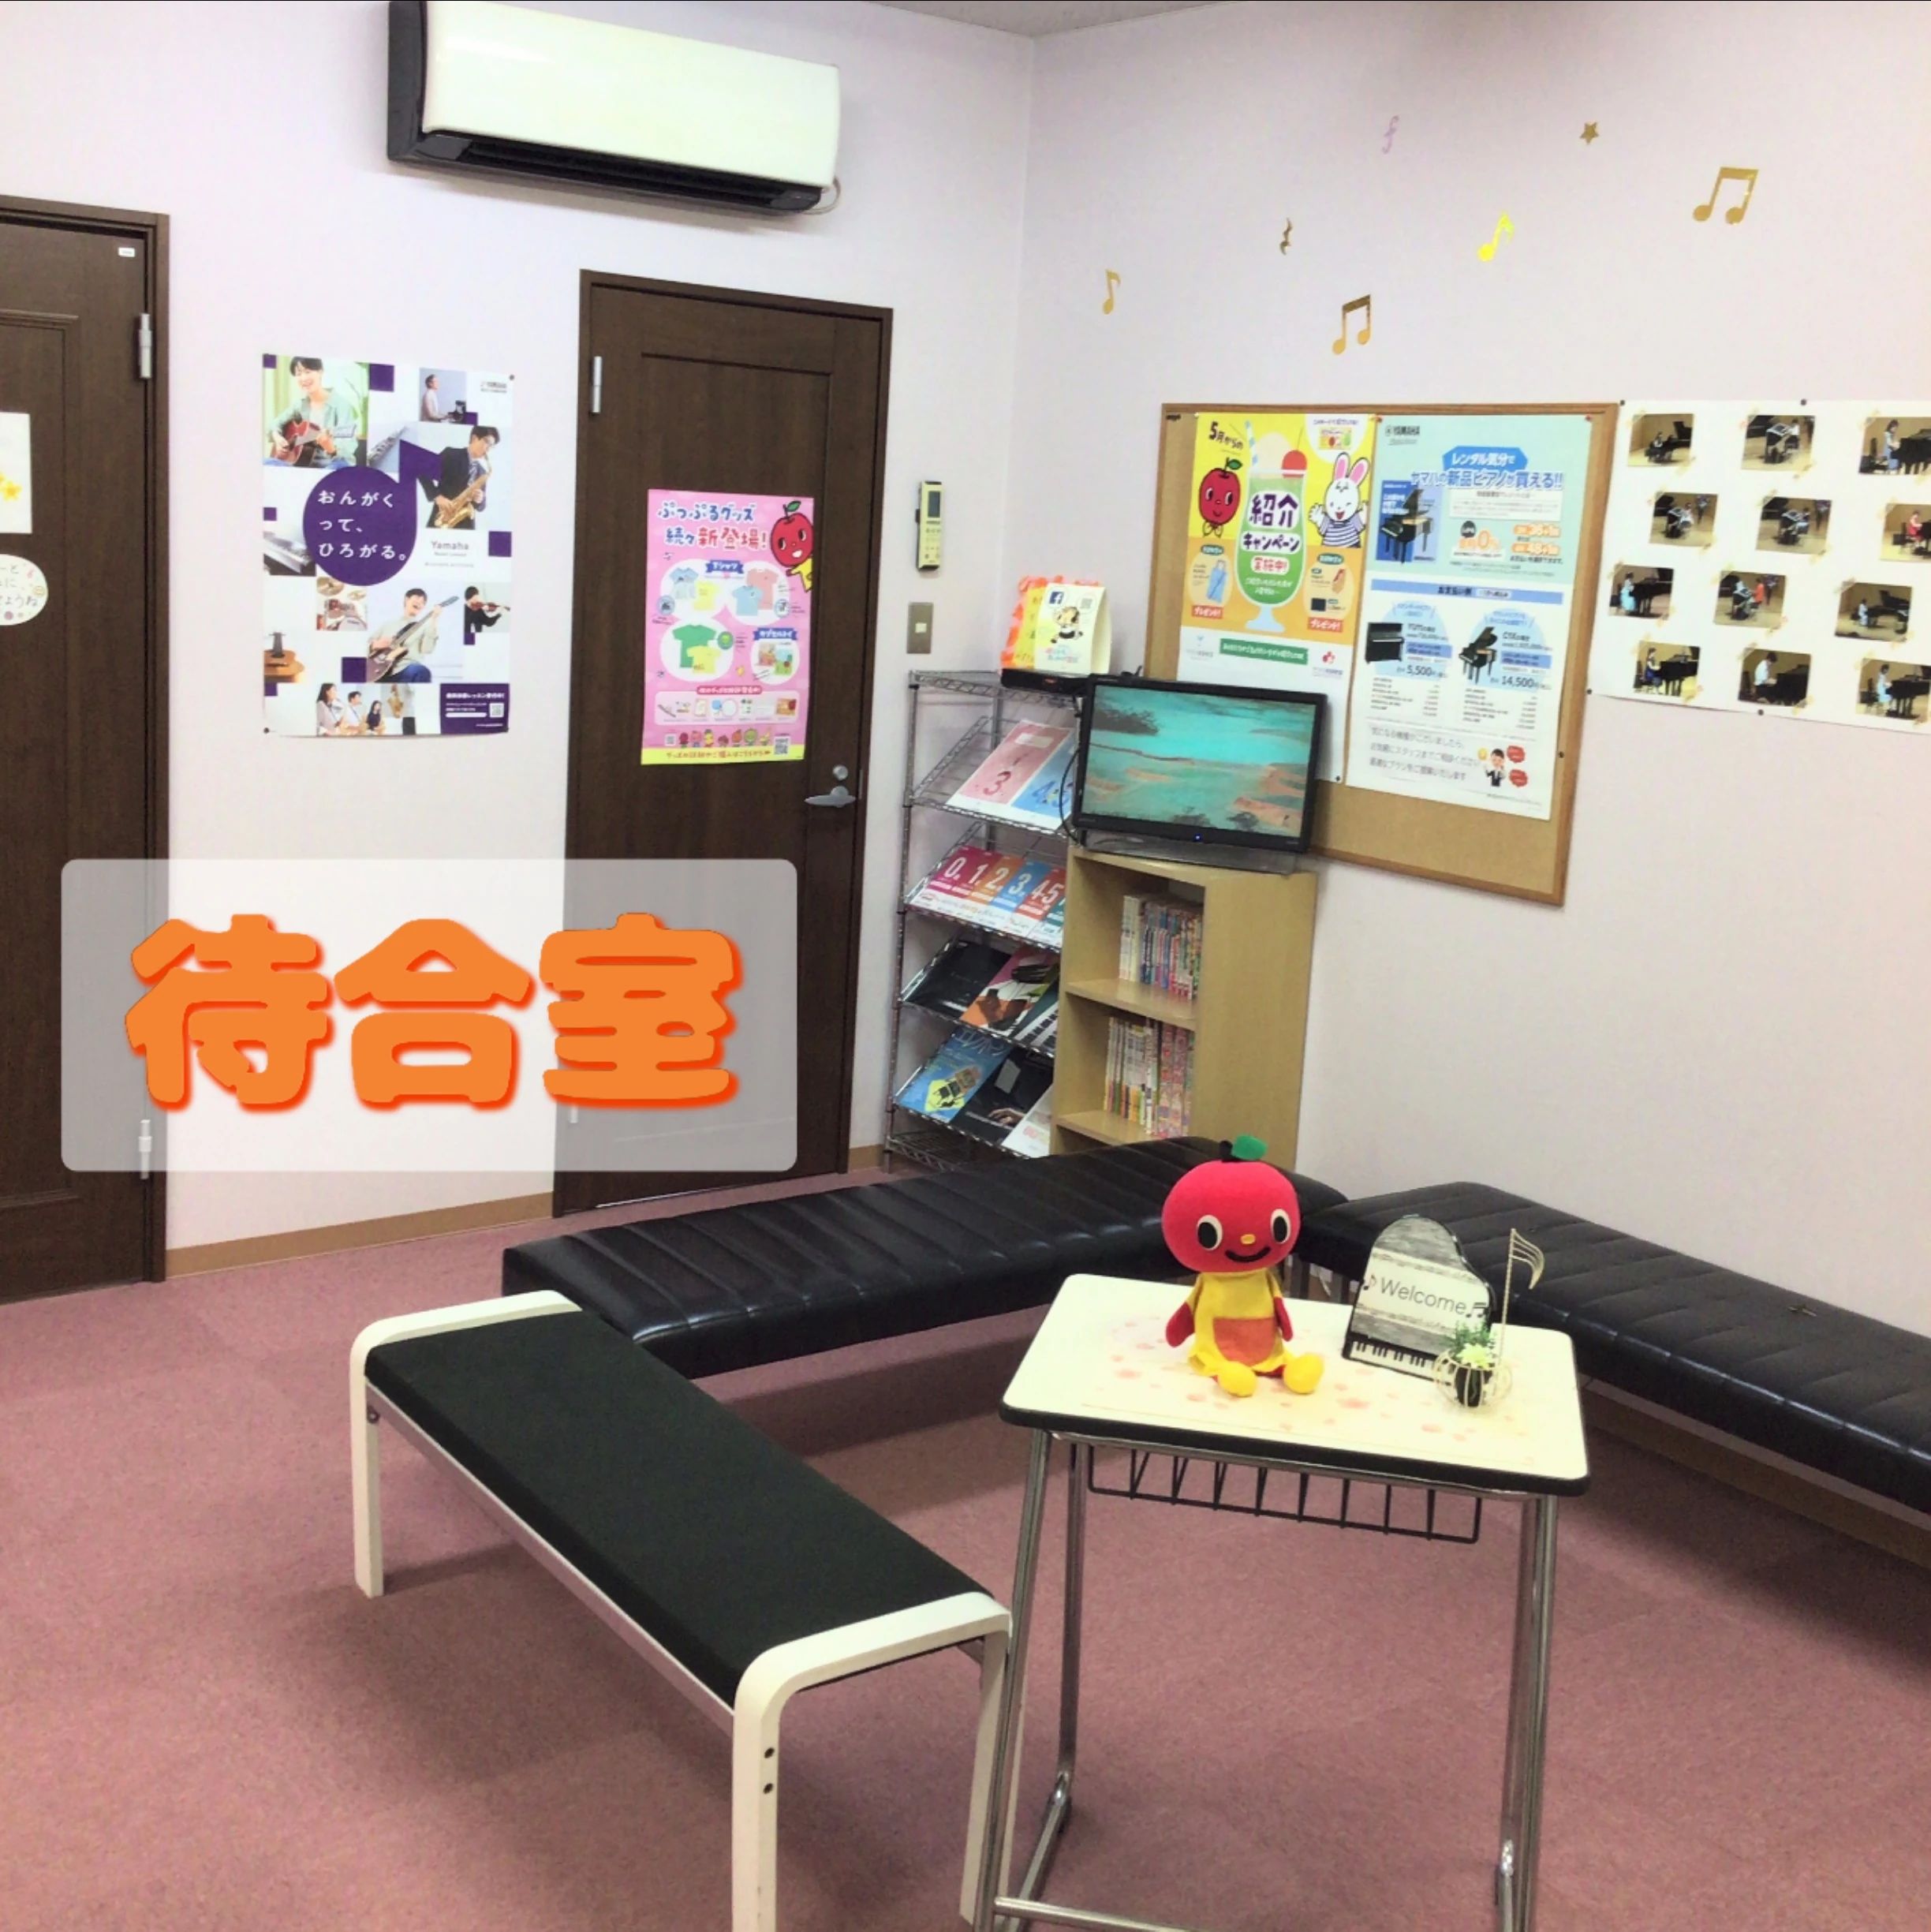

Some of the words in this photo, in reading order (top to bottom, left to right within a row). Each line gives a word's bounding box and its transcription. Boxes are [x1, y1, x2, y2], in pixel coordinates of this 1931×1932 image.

[1451, 452, 1515, 466] レンタル気分で
[317, 490, 394, 507] おんがく
[1252, 493, 1298, 528] 紹介
[431, 540, 469, 551] Yamaha
[1243, 533, 1300, 552] キャンペーン
[318, 543, 406, 562] ひろがる。
[1380, 1276, 1467, 1316] Welcome
